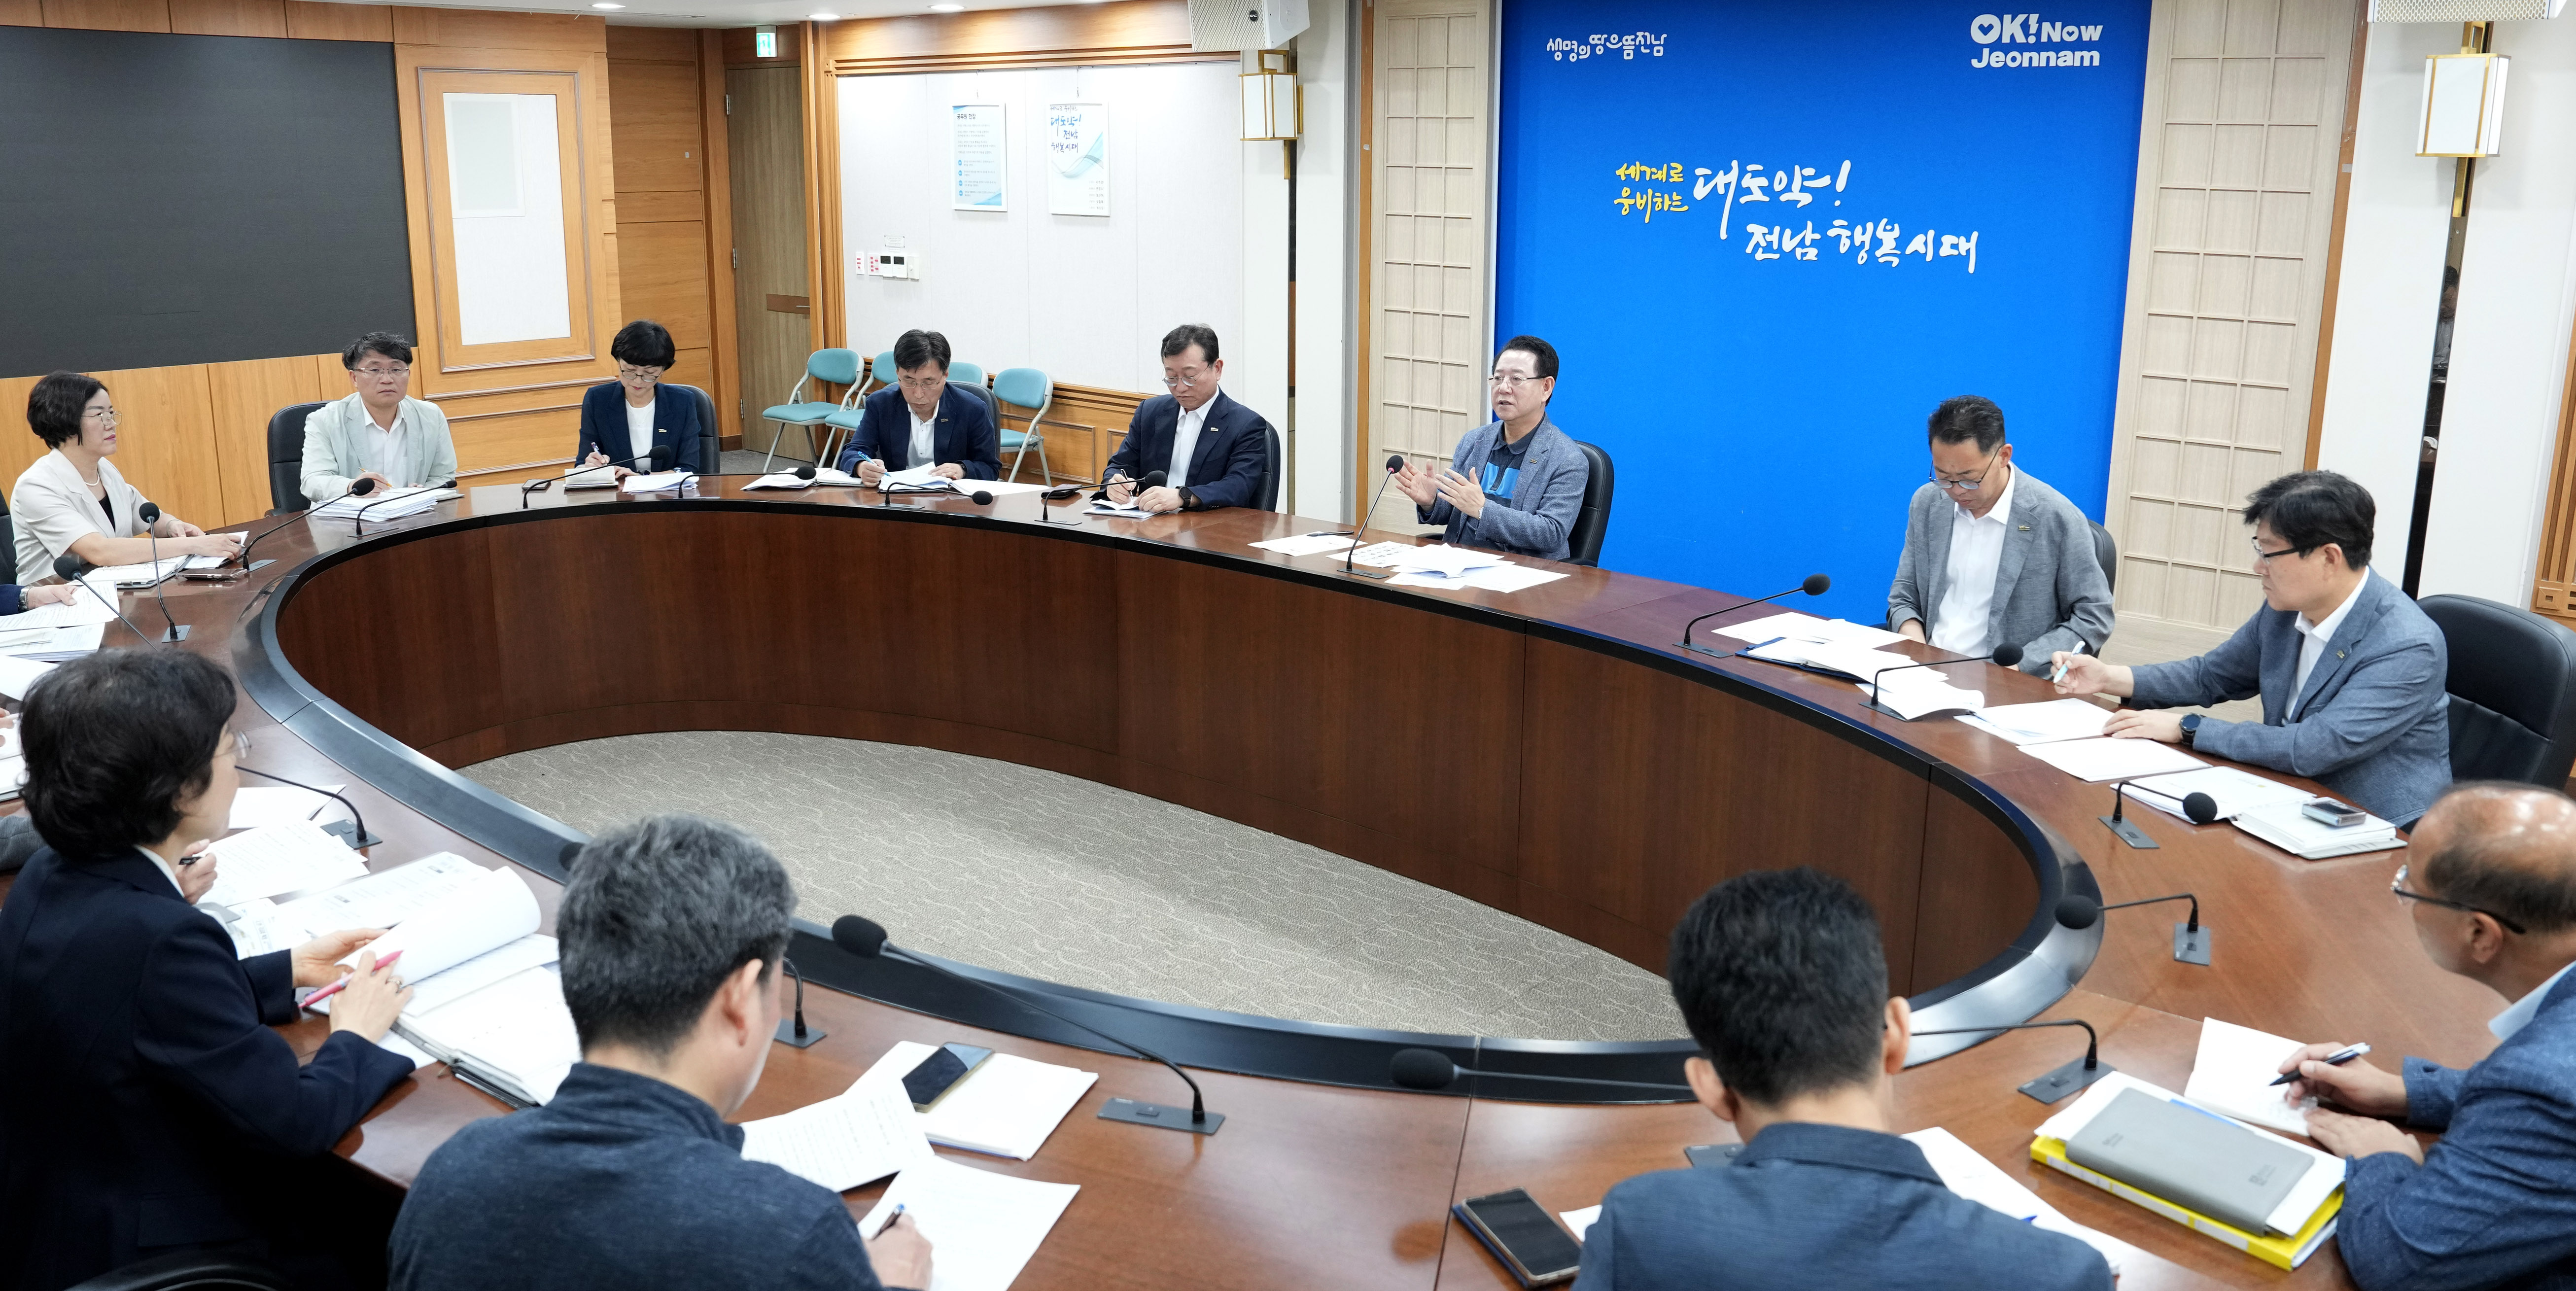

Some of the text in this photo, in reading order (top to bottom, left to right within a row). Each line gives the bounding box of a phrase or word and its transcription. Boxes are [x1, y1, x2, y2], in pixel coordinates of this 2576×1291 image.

[1970, 14, 2039, 44] OK!
[1971, 48, 2100, 68] Jeonnam
[1050, 114, 1081, 137] 대도약!
[1063, 128, 1079, 140] 전남
[1615, 161, 1684, 183] 세계로
[1613, 187, 1689, 223] 웅비하는
[1693, 160, 1851, 240] 대도약!
[1745, 220, 1821, 261] 전남
